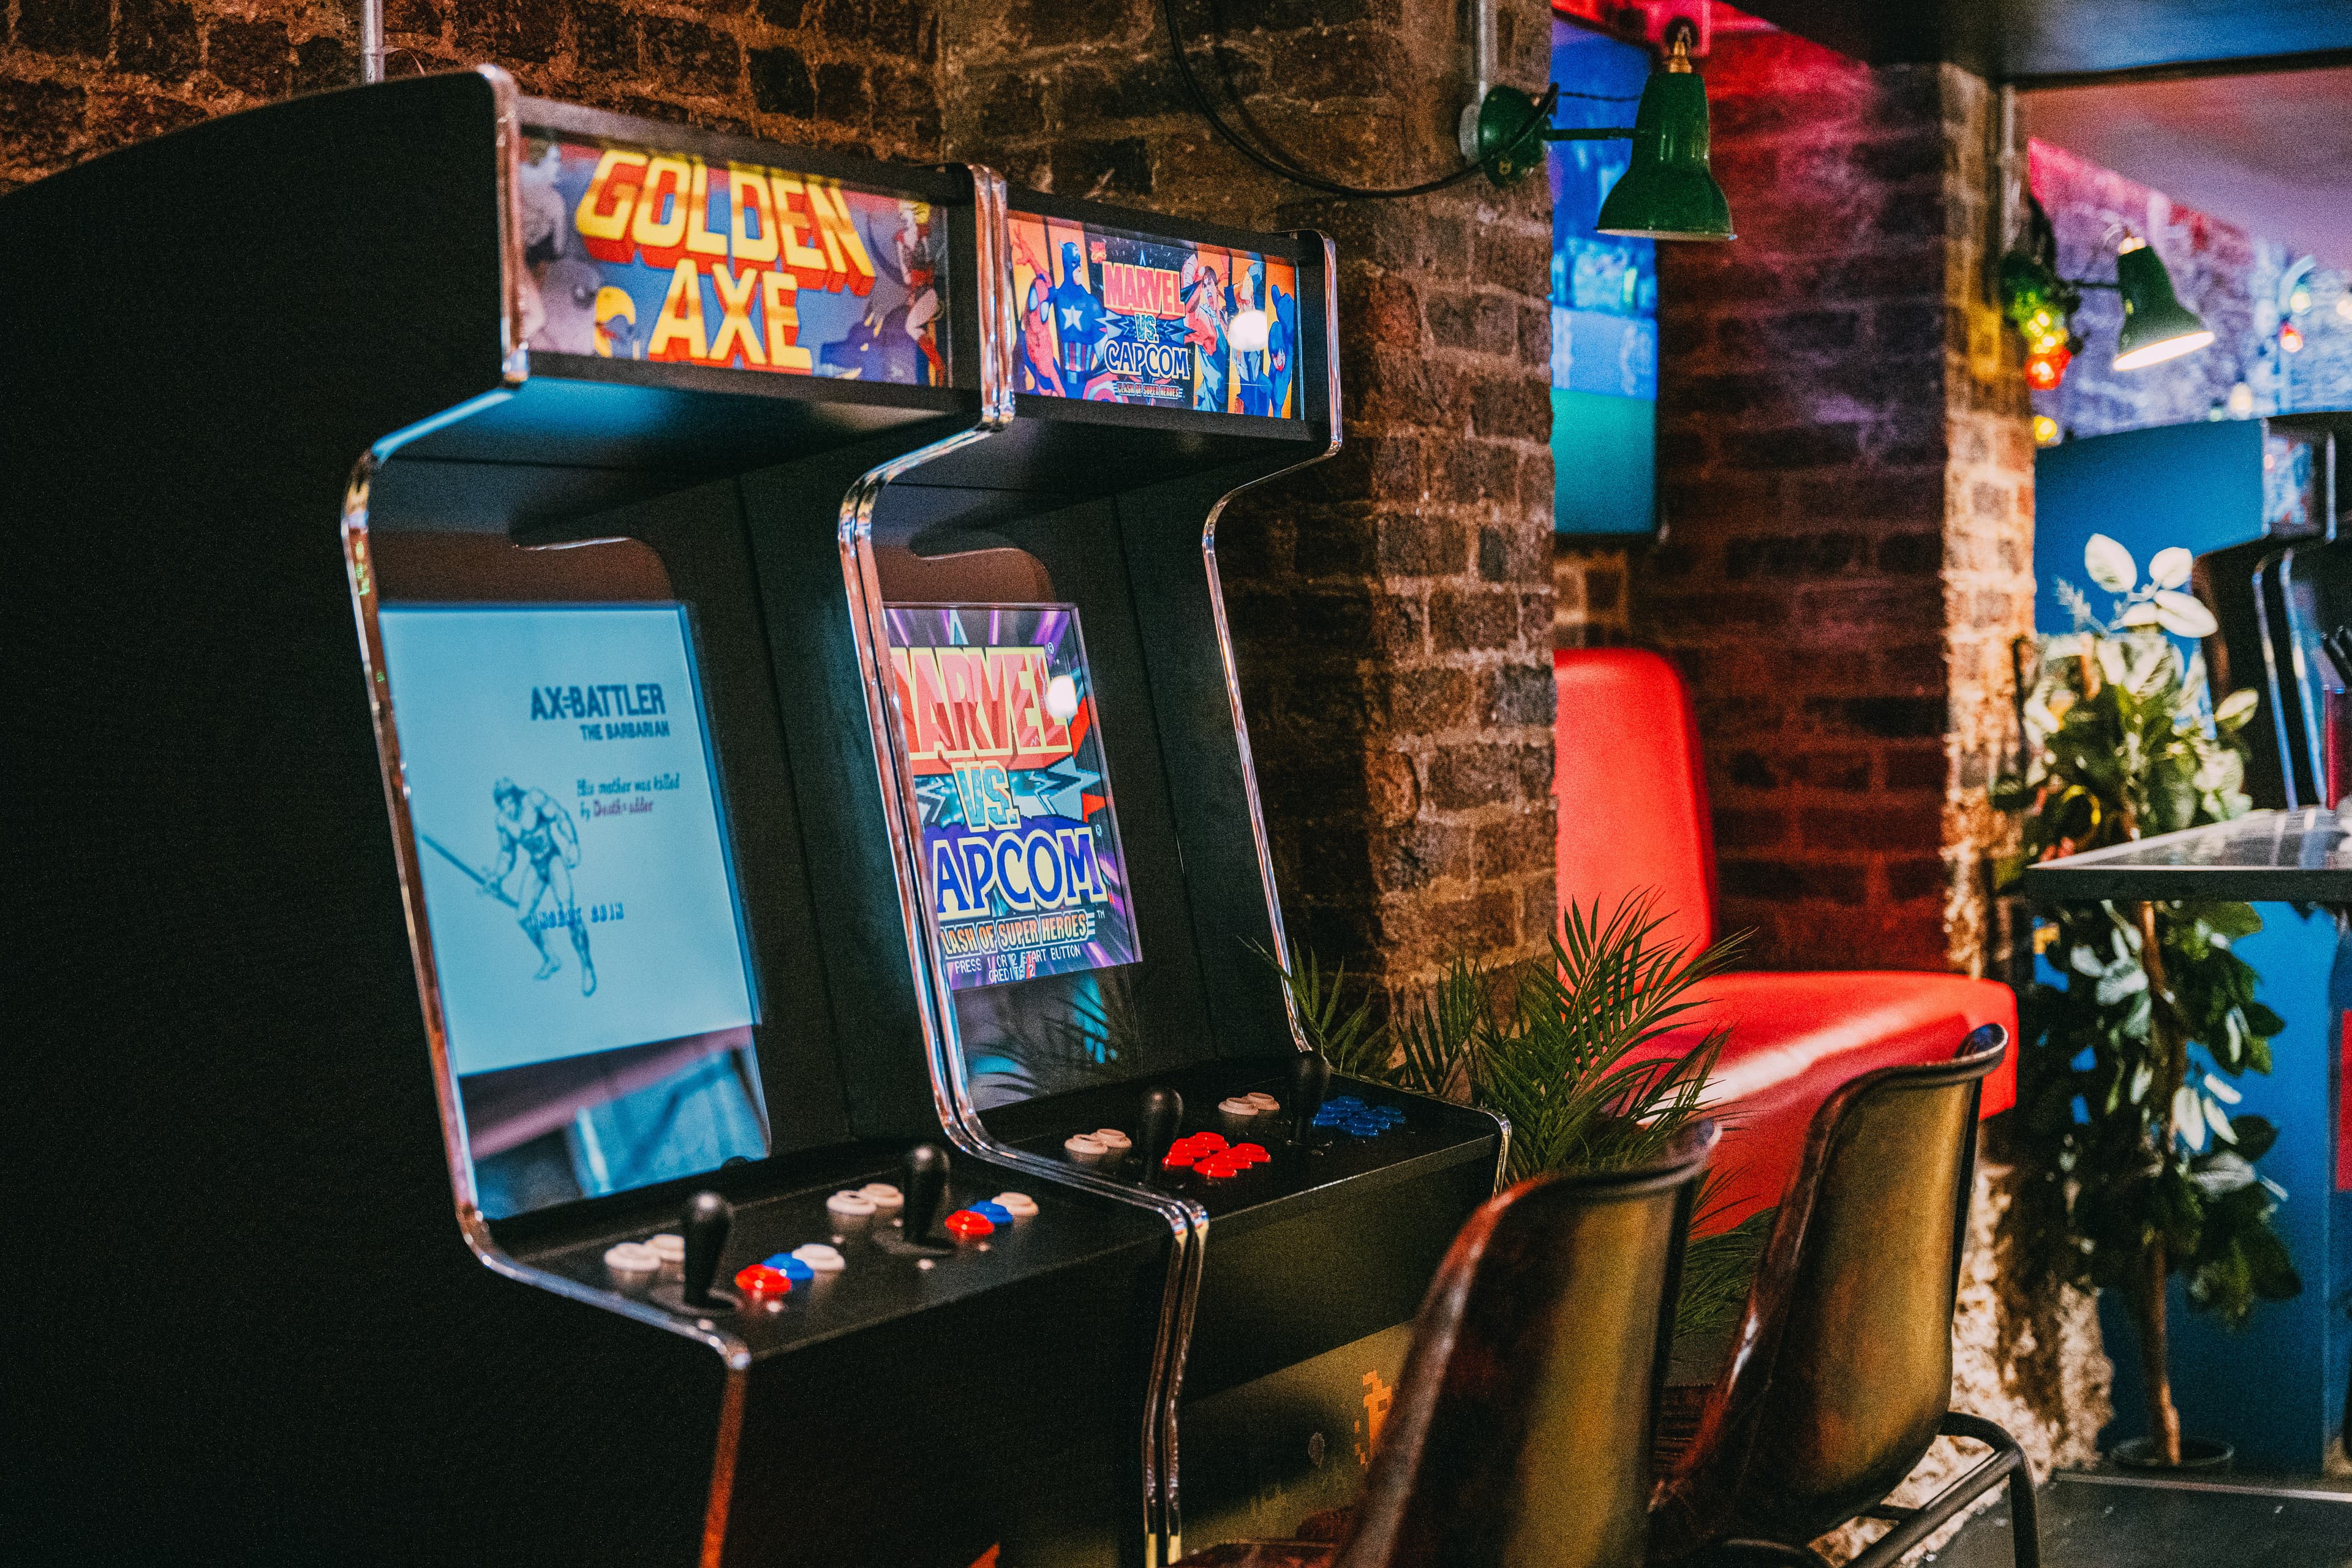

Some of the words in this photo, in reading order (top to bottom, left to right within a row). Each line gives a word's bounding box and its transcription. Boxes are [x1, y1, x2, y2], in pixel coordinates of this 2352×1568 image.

[576, 149, 875, 287] GOLDEN
[1102, 261, 1185, 316] MARVEL
[648, 258, 813, 372] AXE
[1134, 312, 1159, 343] VS.
[1104, 340, 1189, 380] CAPCOM
[1117, 382, 1134, 394] CLASH
[1135, 383, 1142, 394] OF
[1143, 385, 1159, 396] SUPER
[1160, 386, 1179, 398] HEROES
[579, 723, 603, 740] THE
[951, 760, 1021, 832] VS.
[933, 827, 1108, 919] APCOM
[941, 924, 978, 955] LASH
[978, 924, 996, 951] OF
[998, 919, 1040, 948] SUPER
[1041, 913, 1087, 942] HEROES
[954, 957, 982, 974] PRESS
[997, 954, 1008, 968] OR
[1011, 953, 1018, 967] 2
[1020, 949, 1047, 964] START
[1050, 944, 1082, 960] BUTTON
[989, 966, 1025, 984] CREDITS
[1028, 963, 1036, 977] 2
